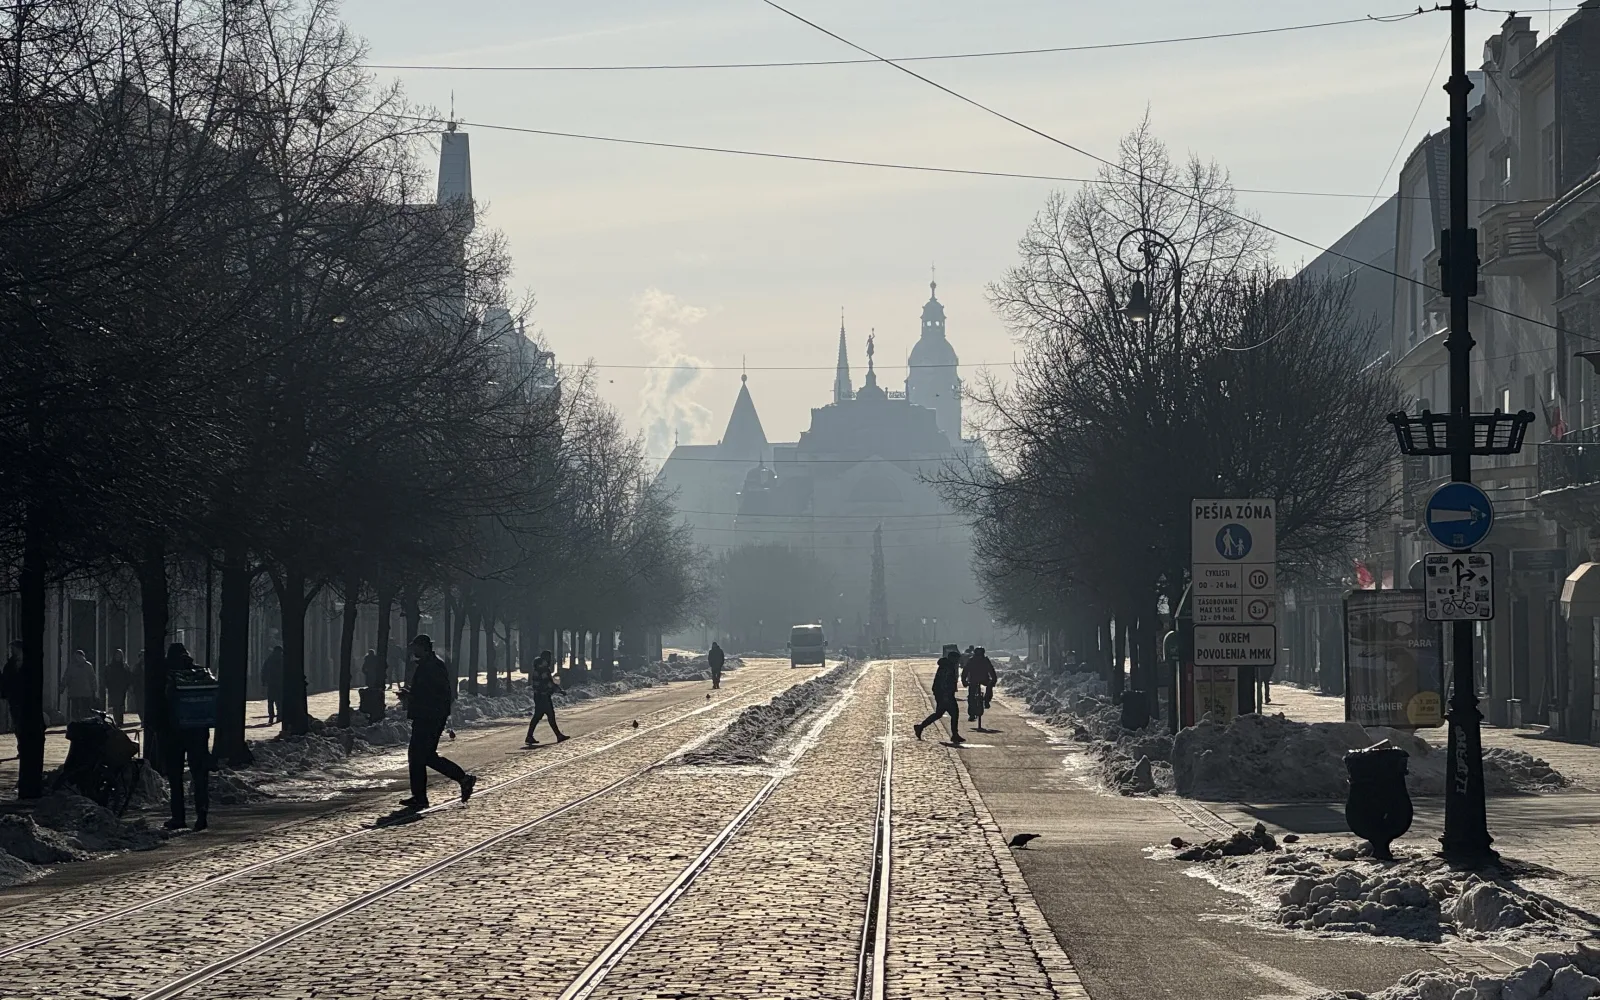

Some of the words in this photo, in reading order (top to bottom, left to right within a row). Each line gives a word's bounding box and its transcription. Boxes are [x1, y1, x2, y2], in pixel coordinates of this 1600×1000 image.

[1195, 502, 1232, 519] PEŠIA
[1236, 502, 1272, 519] ZÓNA
[1205, 569, 1230, 577] CYKLISTI
[1253, 575, 1264, 585] 10
[1222, 614, 1237, 622] hod.
[1219, 632, 1250, 643] OKREM
[1408, 639, 1432, 648] PARA
[1197, 649, 1246, 660] POVOLENIA
[1249, 648, 1271, 660] MMK
[1352, 695, 1373, 703] JANA
[1351, 702, 1403, 711] KIRSCHNER
